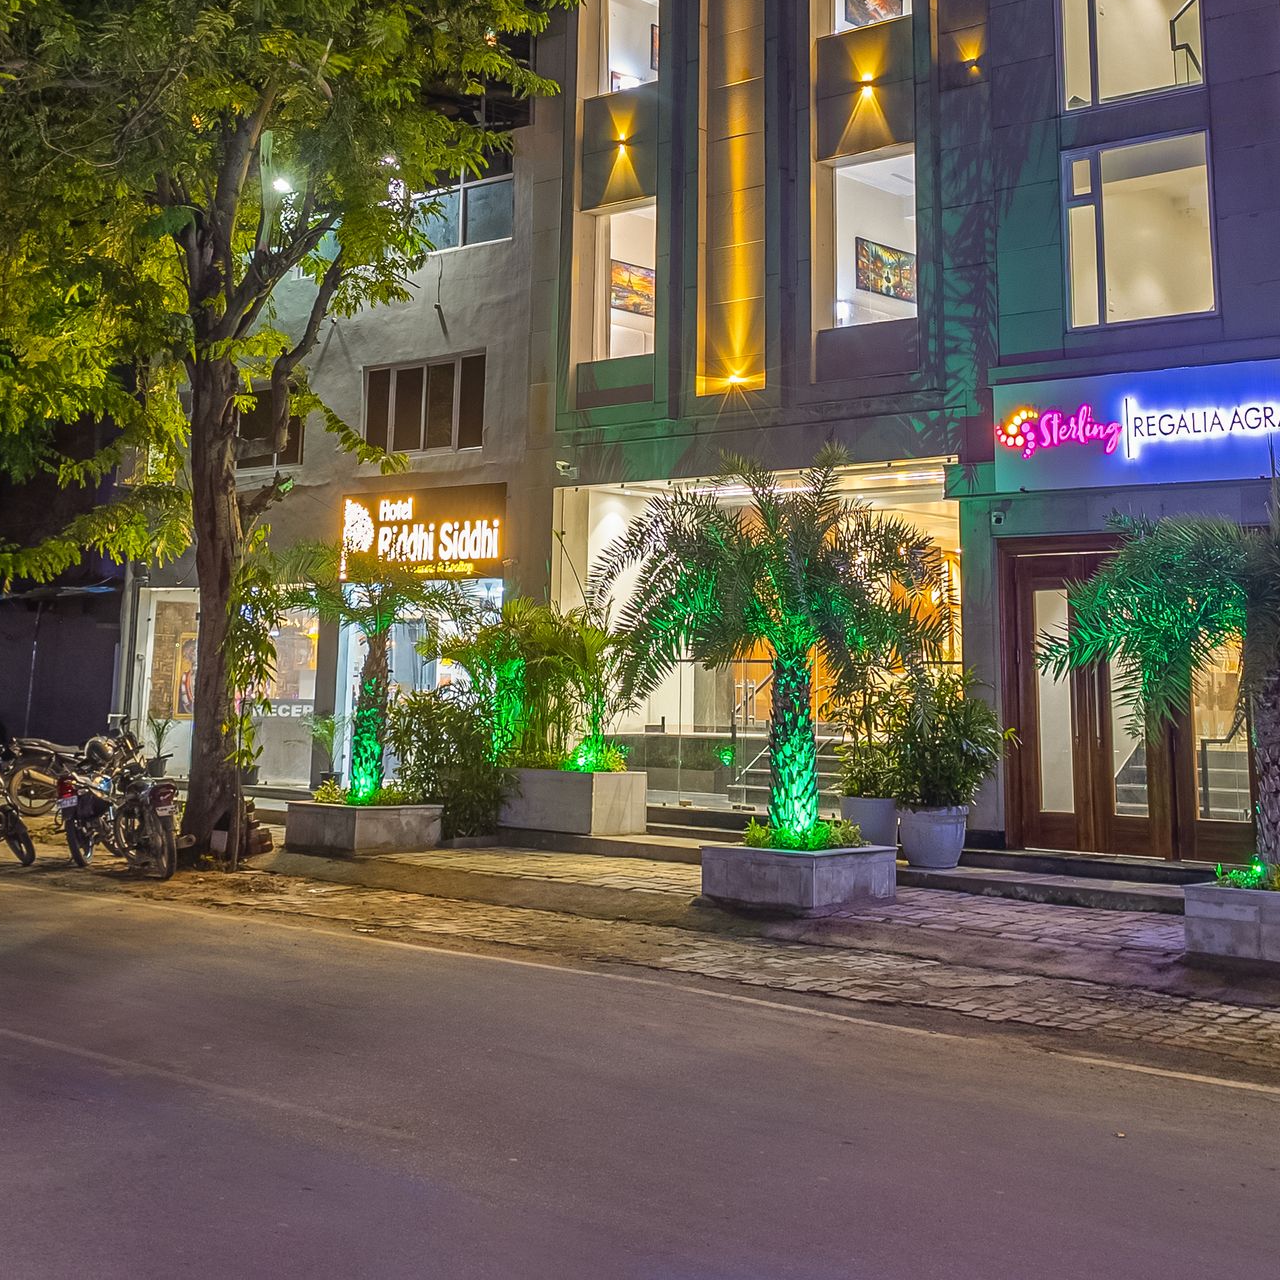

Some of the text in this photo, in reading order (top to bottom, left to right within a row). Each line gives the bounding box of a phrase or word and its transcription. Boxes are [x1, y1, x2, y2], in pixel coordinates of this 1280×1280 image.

[1040, 404, 1122, 454] Sterling
[1133, 410, 1224, 437] REGALIA
[379, 497, 413, 521] Hotel
[377, 519, 500, 562] Riddhi Siddhi
